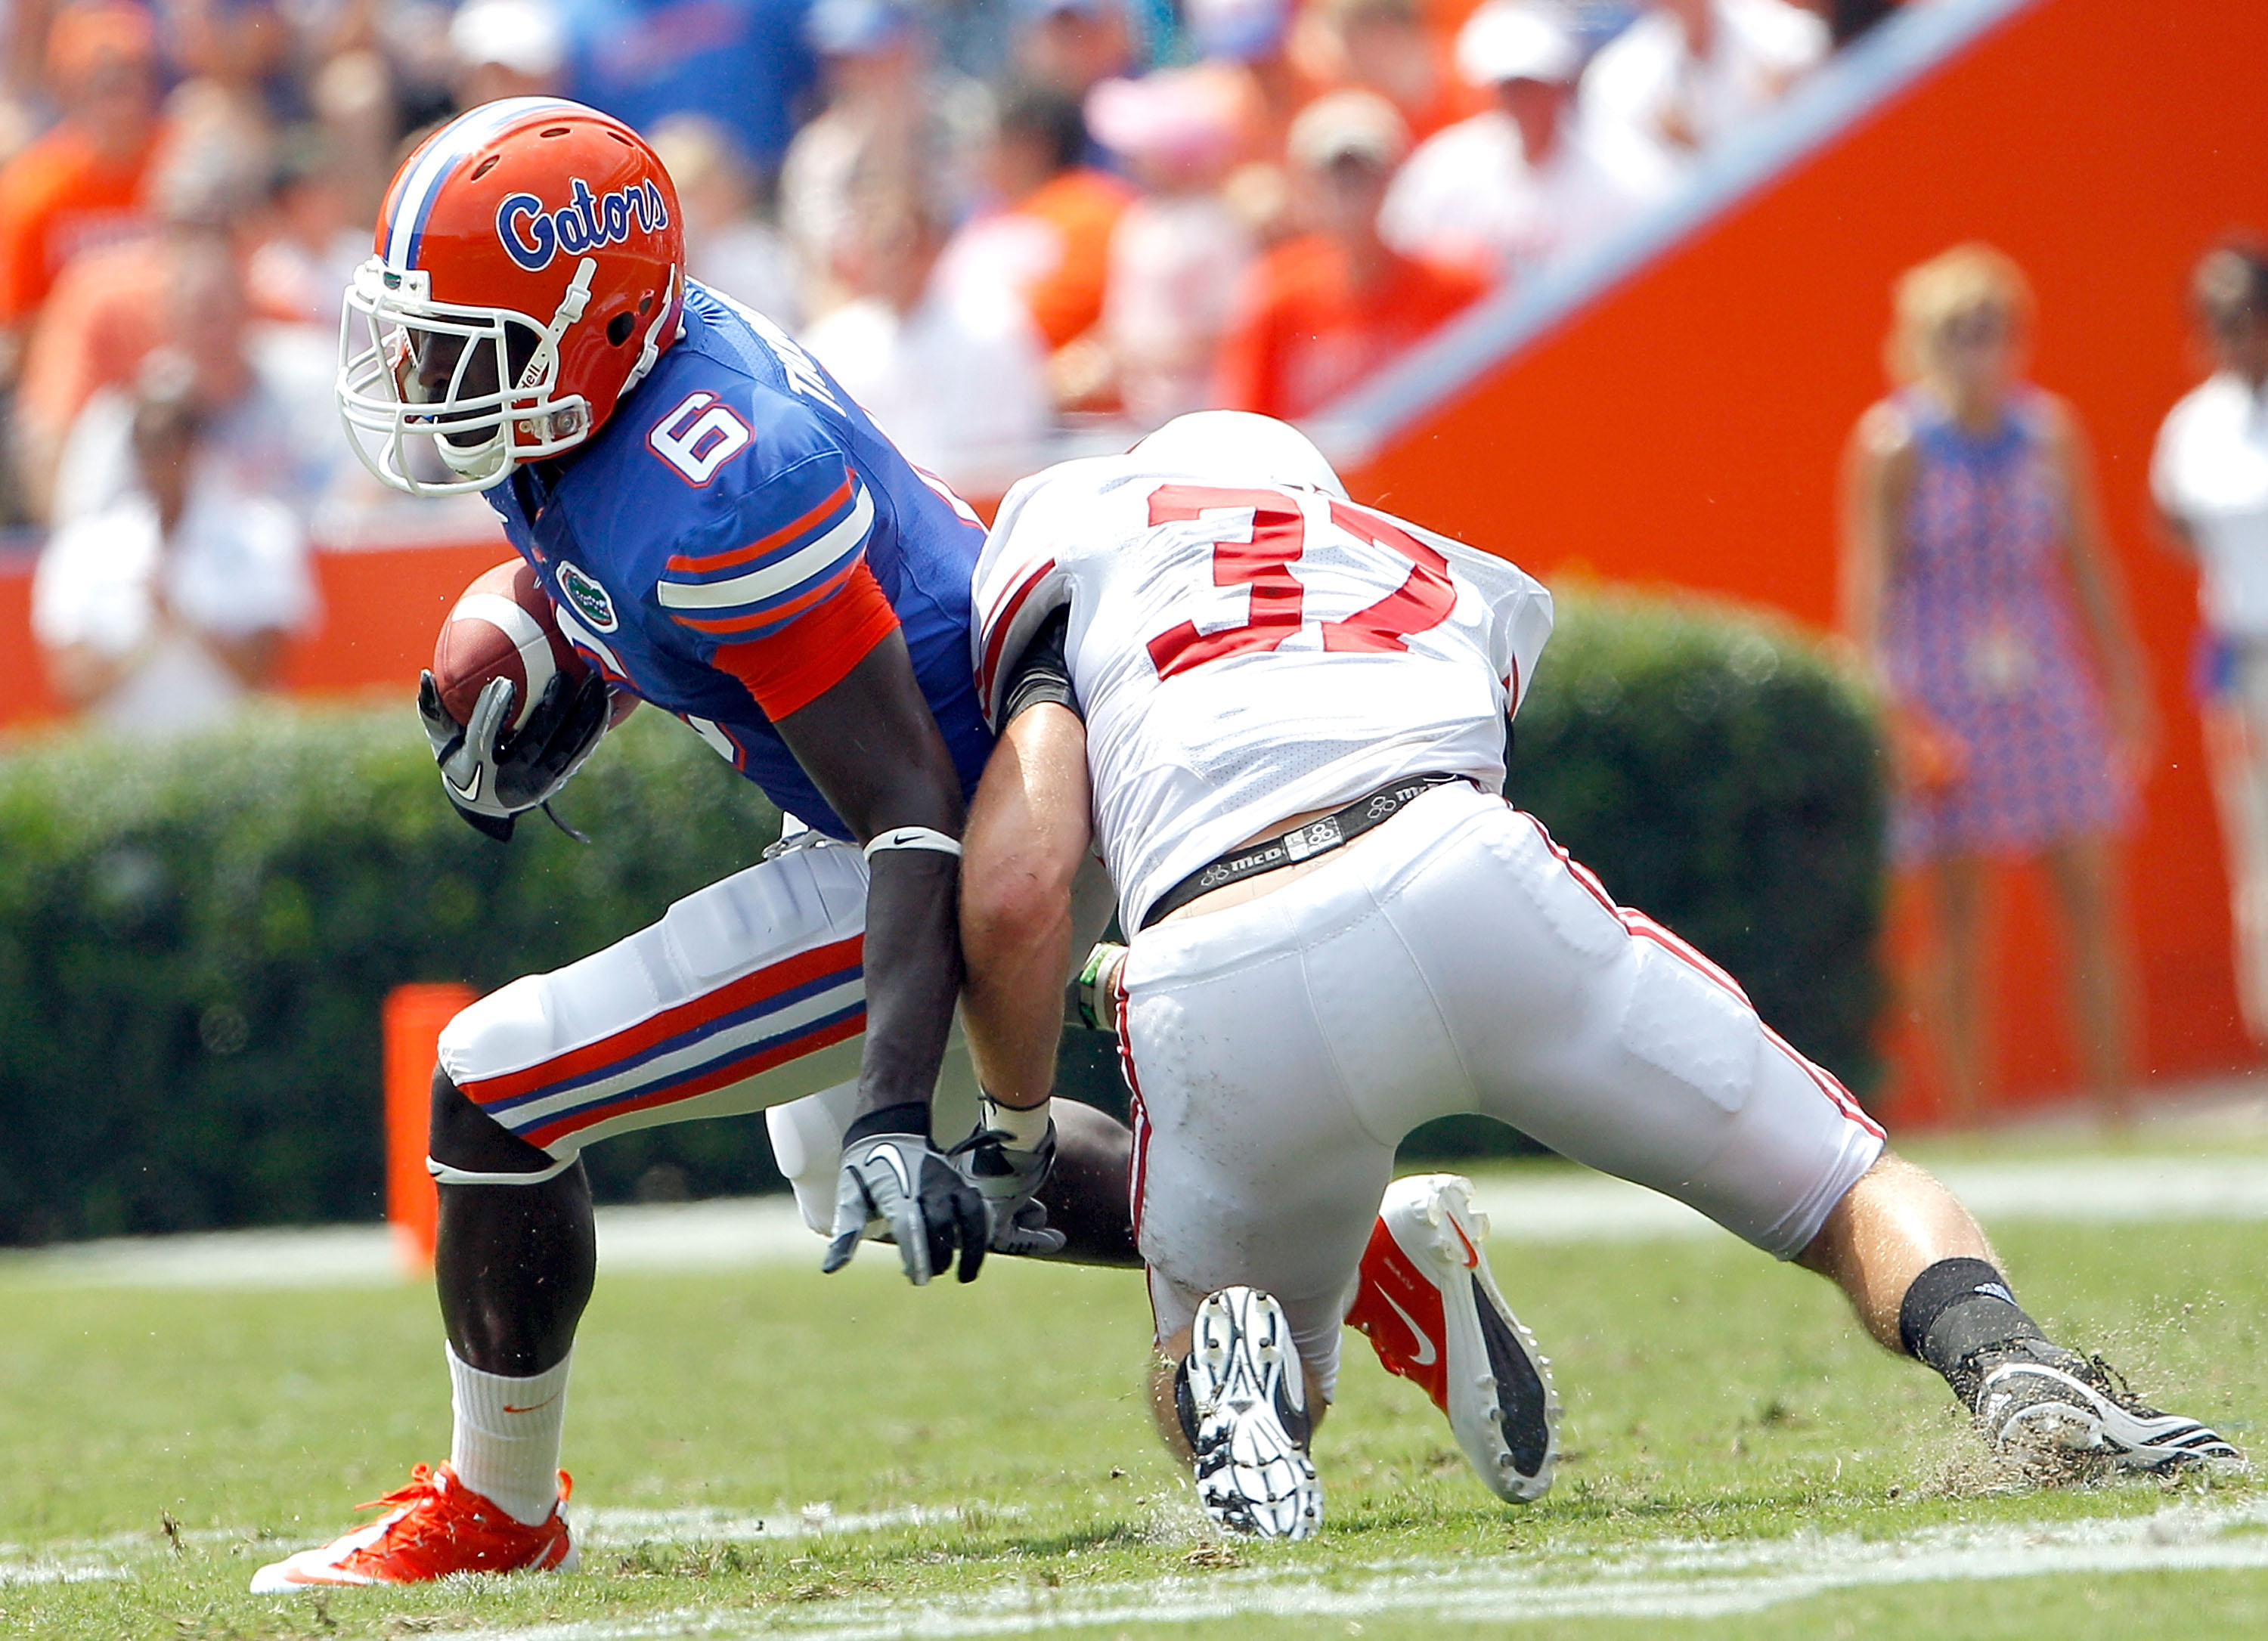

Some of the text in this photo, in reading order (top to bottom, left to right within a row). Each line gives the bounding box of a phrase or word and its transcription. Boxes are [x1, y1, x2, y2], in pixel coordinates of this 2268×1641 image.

[495, 178, 668, 271] Gators
[645, 389, 755, 489] 6
[1147, 484, 1458, 681] 37
